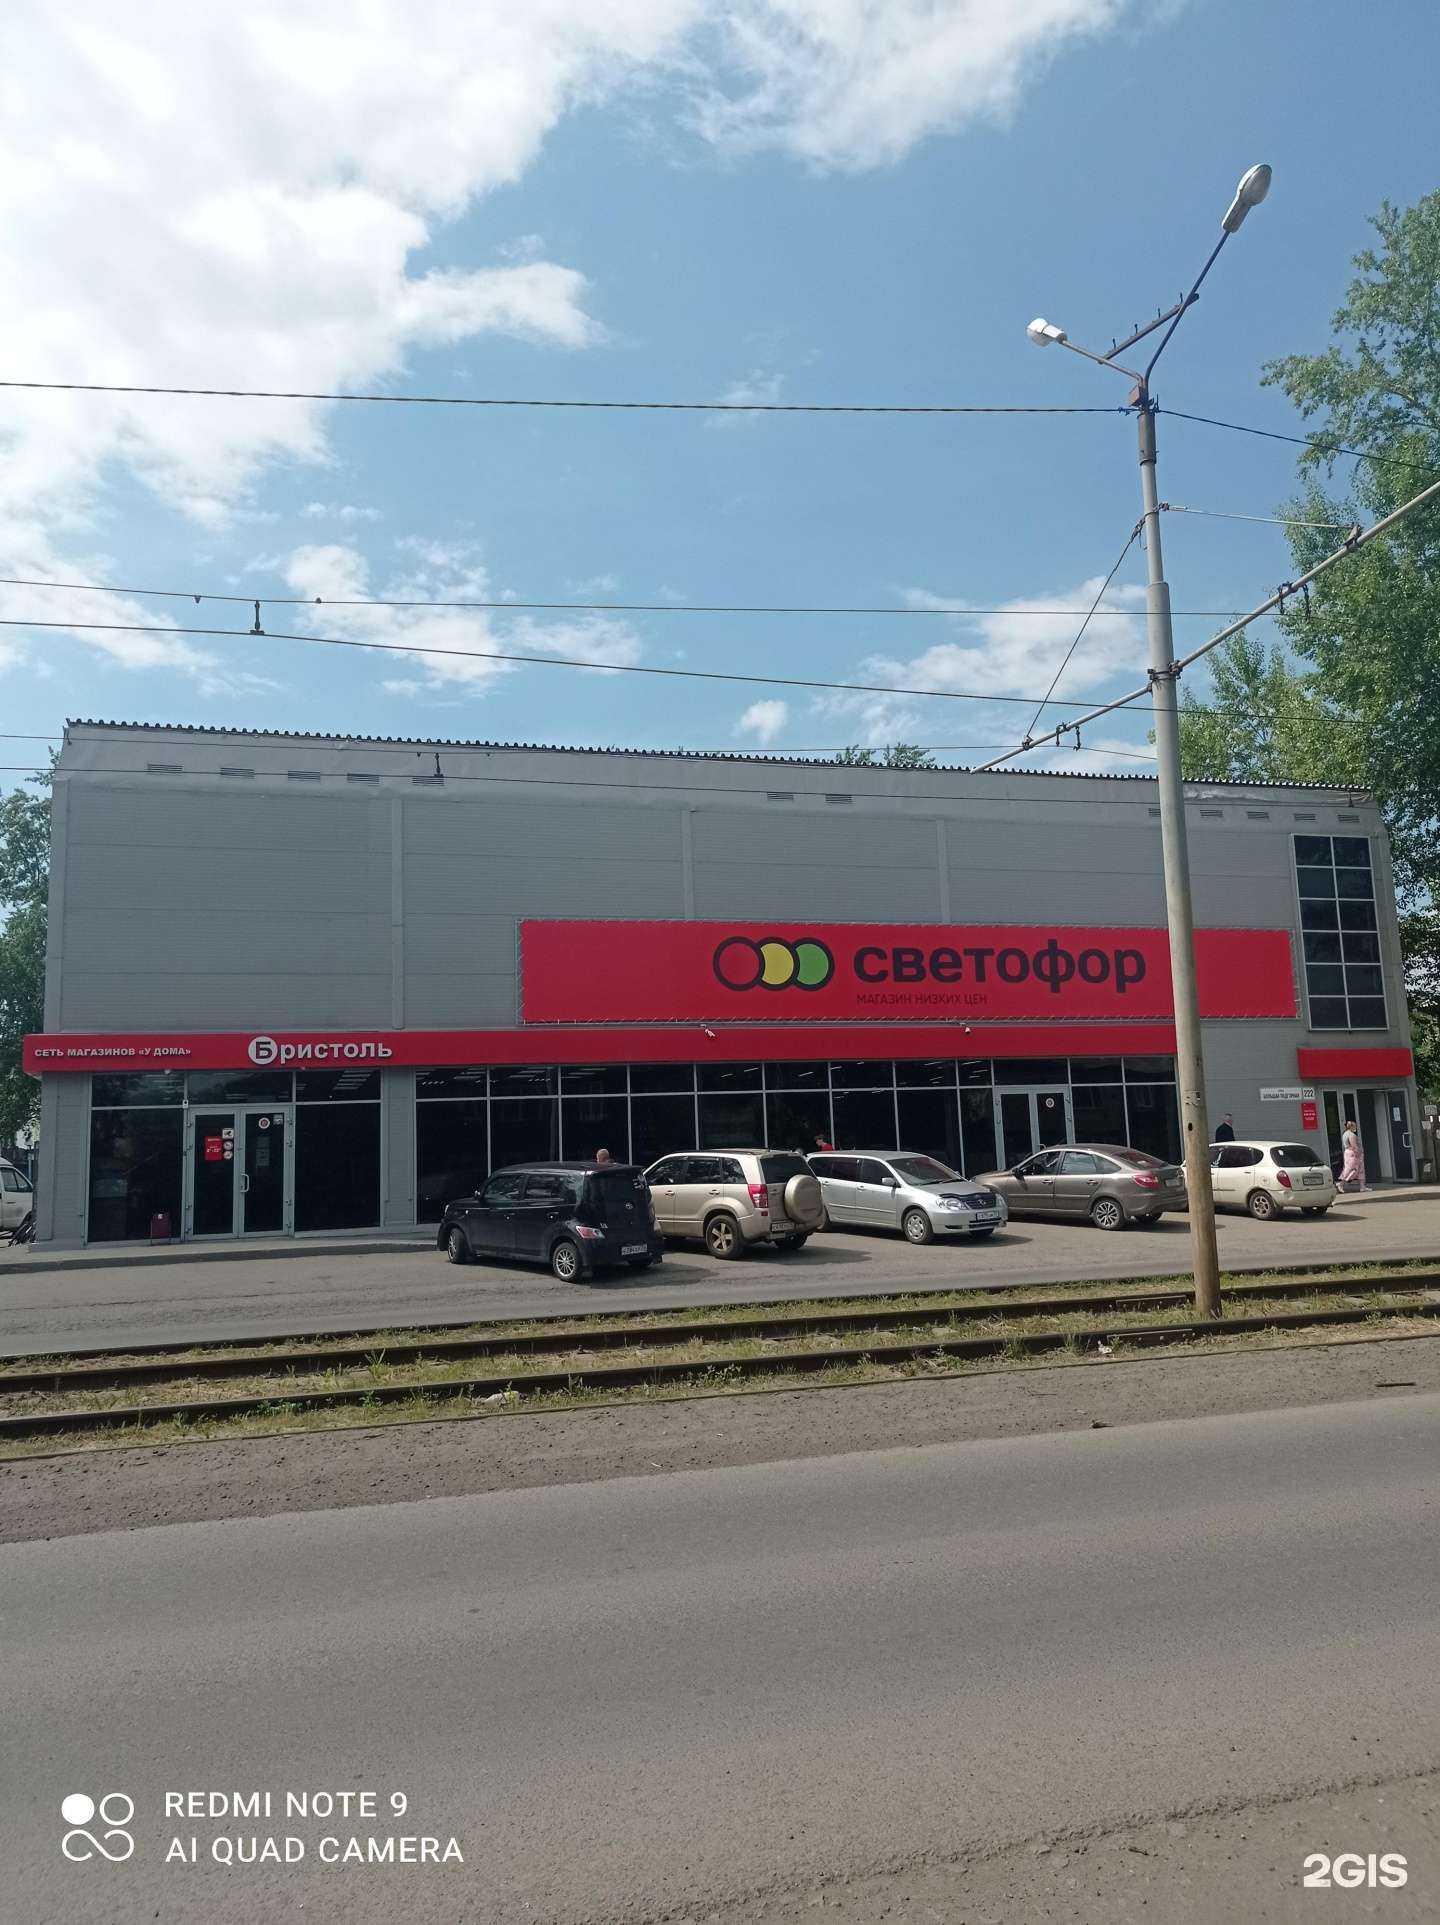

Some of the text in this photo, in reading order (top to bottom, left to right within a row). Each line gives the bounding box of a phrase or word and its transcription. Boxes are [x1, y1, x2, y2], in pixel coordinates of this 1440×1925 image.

[853, 939, 1146, 993] светофор
[856, 993, 987, 1005] МАГАЗИН НИЗКИХ ЦЕН
[34, 1049, 64, 1057] СЕТЬ
[67, 1048, 136, 1057] МАГАЗИНОВ
[153, 1047, 191, 1057] ДОМА»
[253, 1039, 393, 1064] Бристоль
[1303, 1089, 1314, 1098] 222
